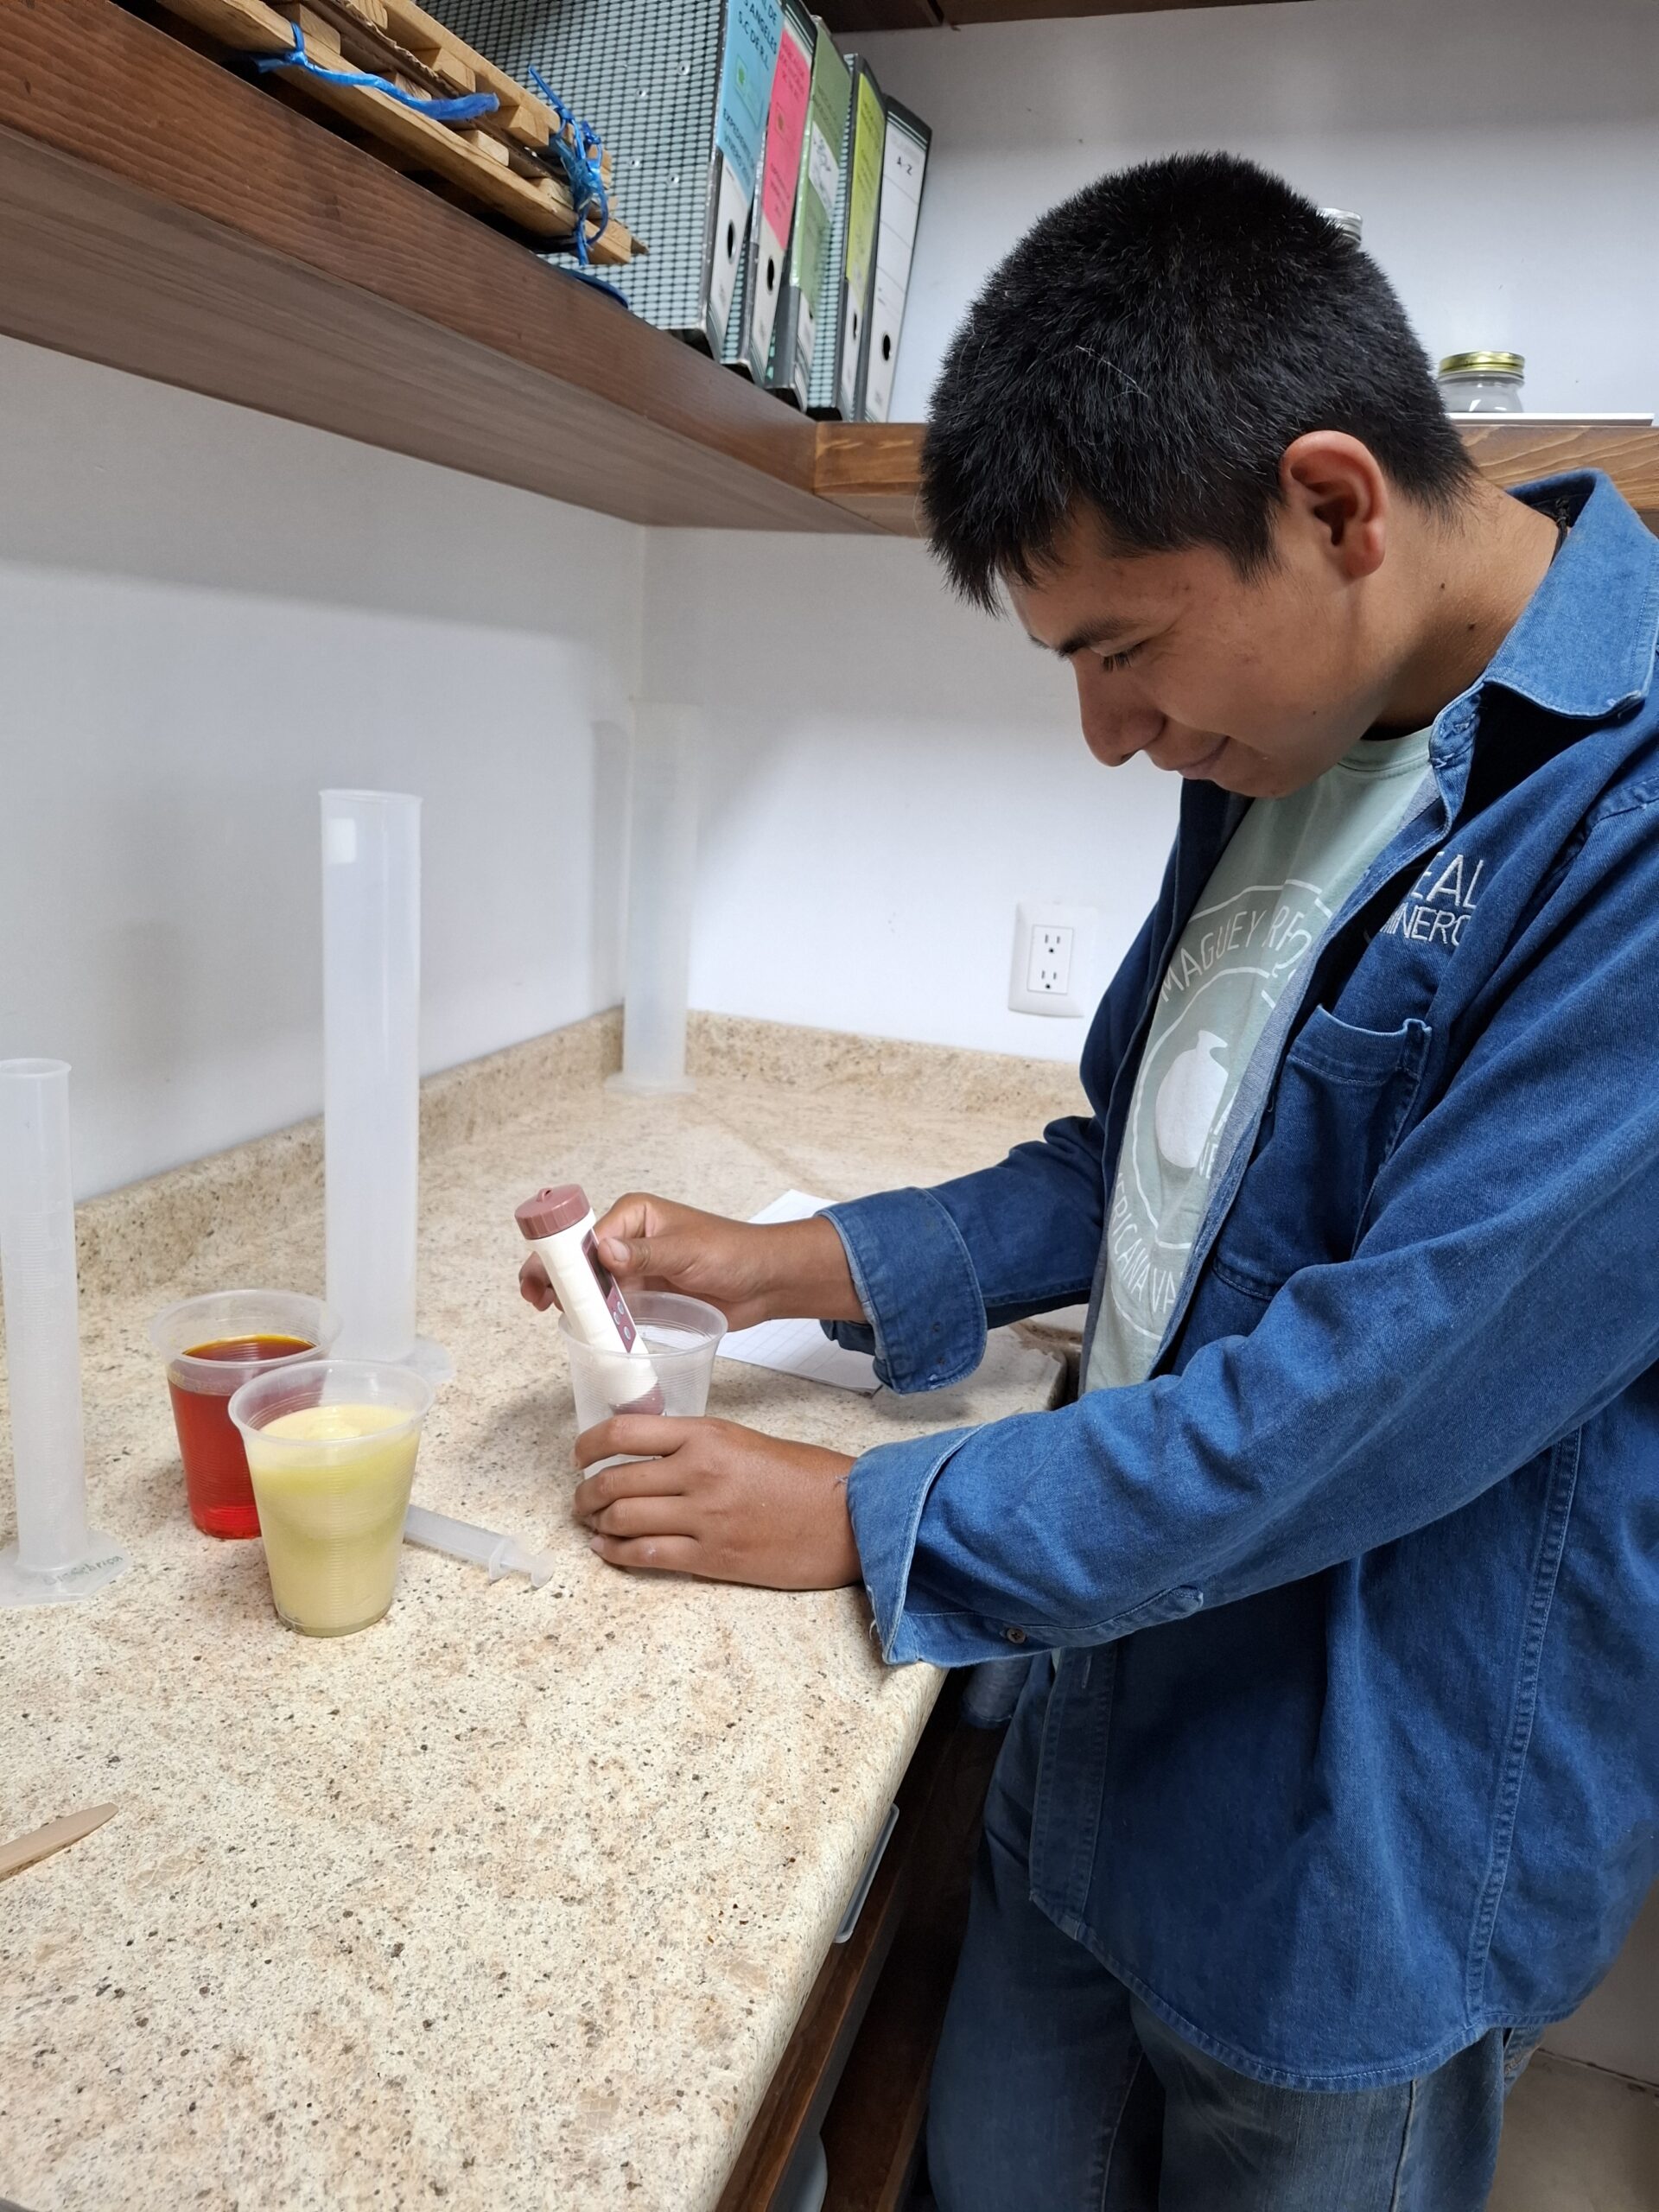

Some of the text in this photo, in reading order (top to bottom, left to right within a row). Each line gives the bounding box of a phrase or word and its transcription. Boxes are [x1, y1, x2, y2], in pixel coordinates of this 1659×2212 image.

[749, 3, 777, 54] ANGELES
[1409, 851, 1484, 908] EAL
[1160, 909, 1268, 1003] MAGUEY
